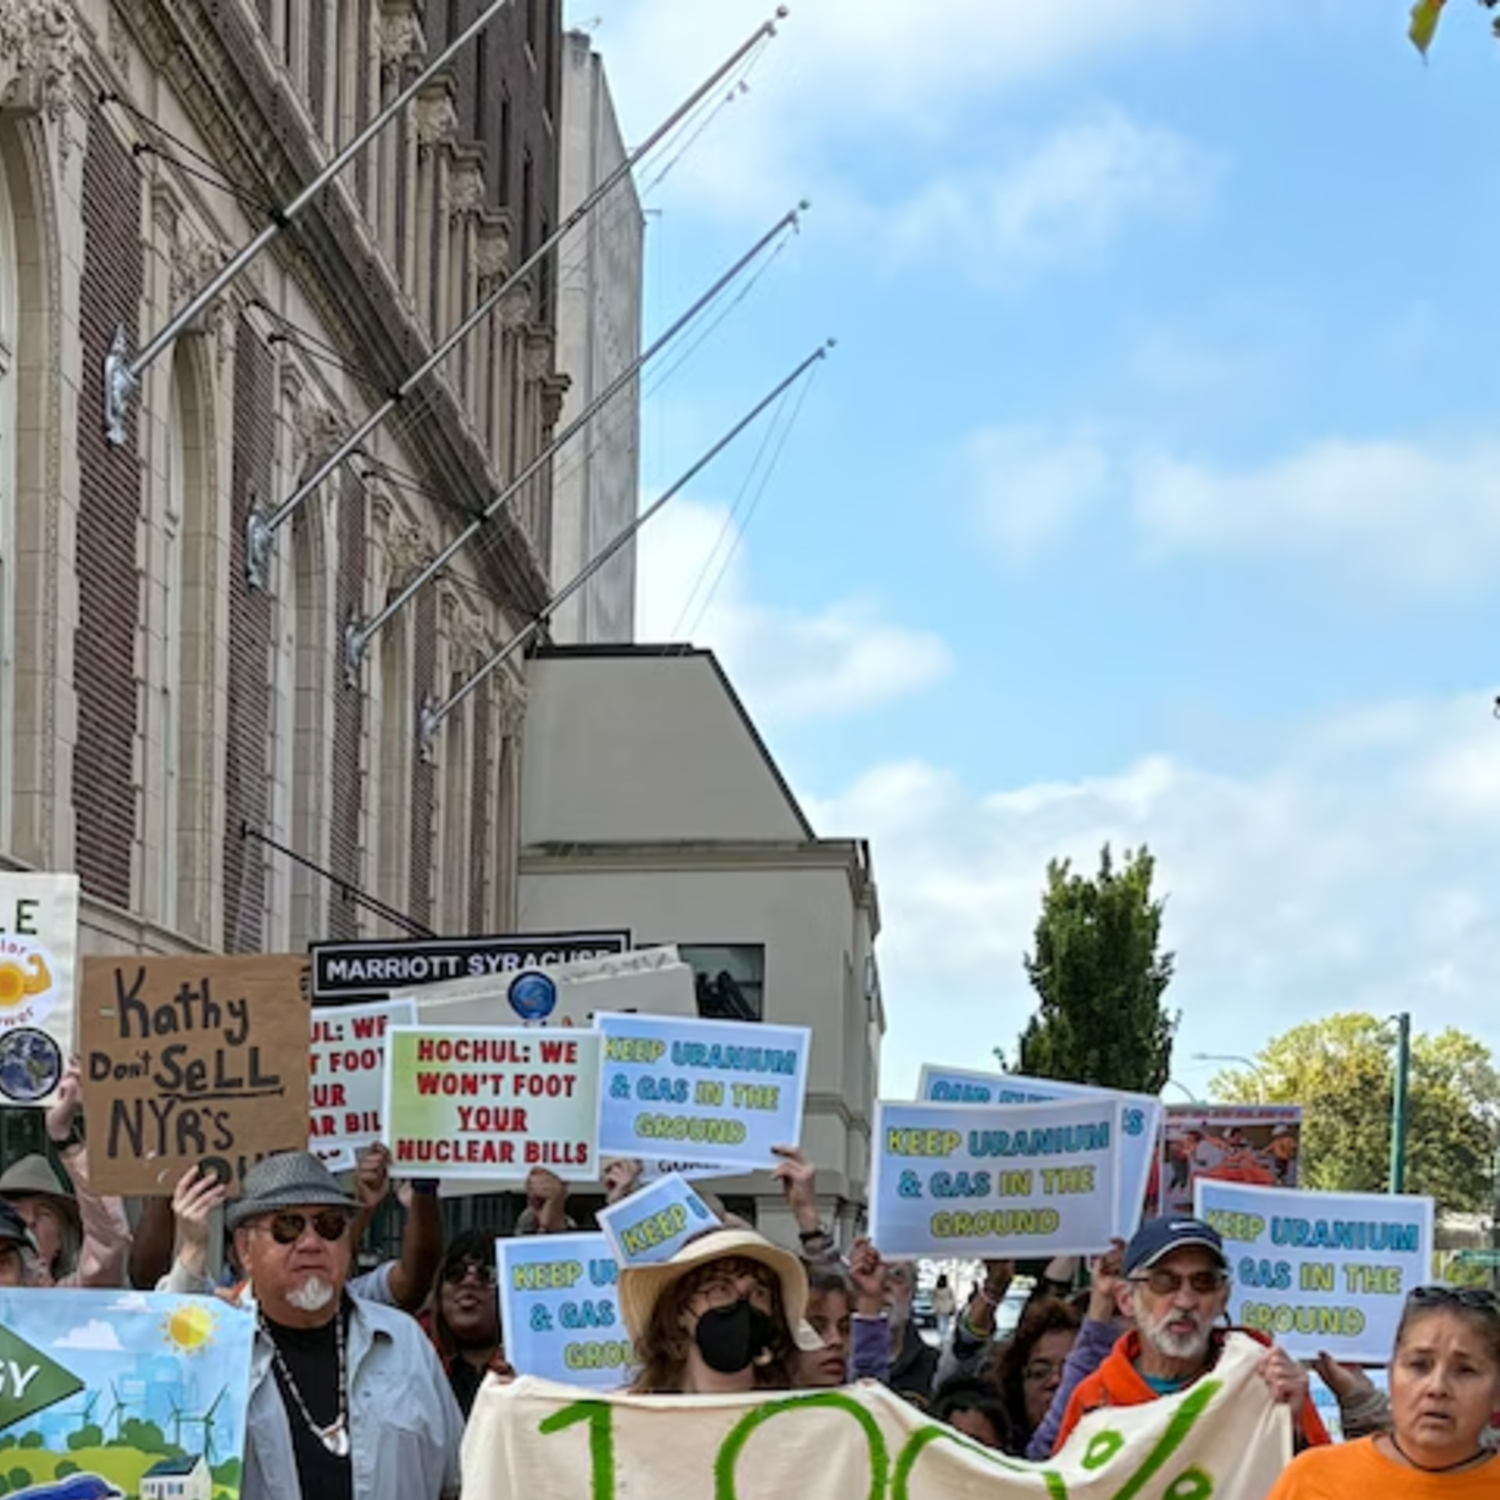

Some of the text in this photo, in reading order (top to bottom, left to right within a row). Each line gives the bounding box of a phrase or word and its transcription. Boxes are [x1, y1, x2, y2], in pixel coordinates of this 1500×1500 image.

[326, 955, 461, 982] MARRIOTT
[466, 948, 611, 977] SYRACUS
[113, 965, 250, 1047] Kathy
[417, 1038, 578, 1063] HOCHUL: WE
[605, 1036, 797, 1076] KEEP URANIUM
[311, 1083, 347, 1107] UR
[416, 1072, 577, 1098] WON'T FOOT
[609, 1072, 780, 1112] & GAS IN THE
[345, 1111, 382, 1134] BIL
[456, 1105, 529, 1132] YOUR
[633, 1111, 747, 1145] GROUND
[396, 1138, 589, 1164] NUCLEAR BILLS
[886, 1120, 1111, 1158] KEEP URANIUM
[897, 1164, 1097, 1199] & GAS IN THE
[621, 1202, 688, 1257] KEEP
[929, 1206, 1061, 1239] GROUND
[1269, 1215, 1420, 1253] URANIUM
[511, 1260, 584, 1291] KEEP
[1237, 1256, 1404, 1295] GAS IN THE
[529, 1299, 616, 1332] & GAS
[564, 1339, 642, 1370] GROU
